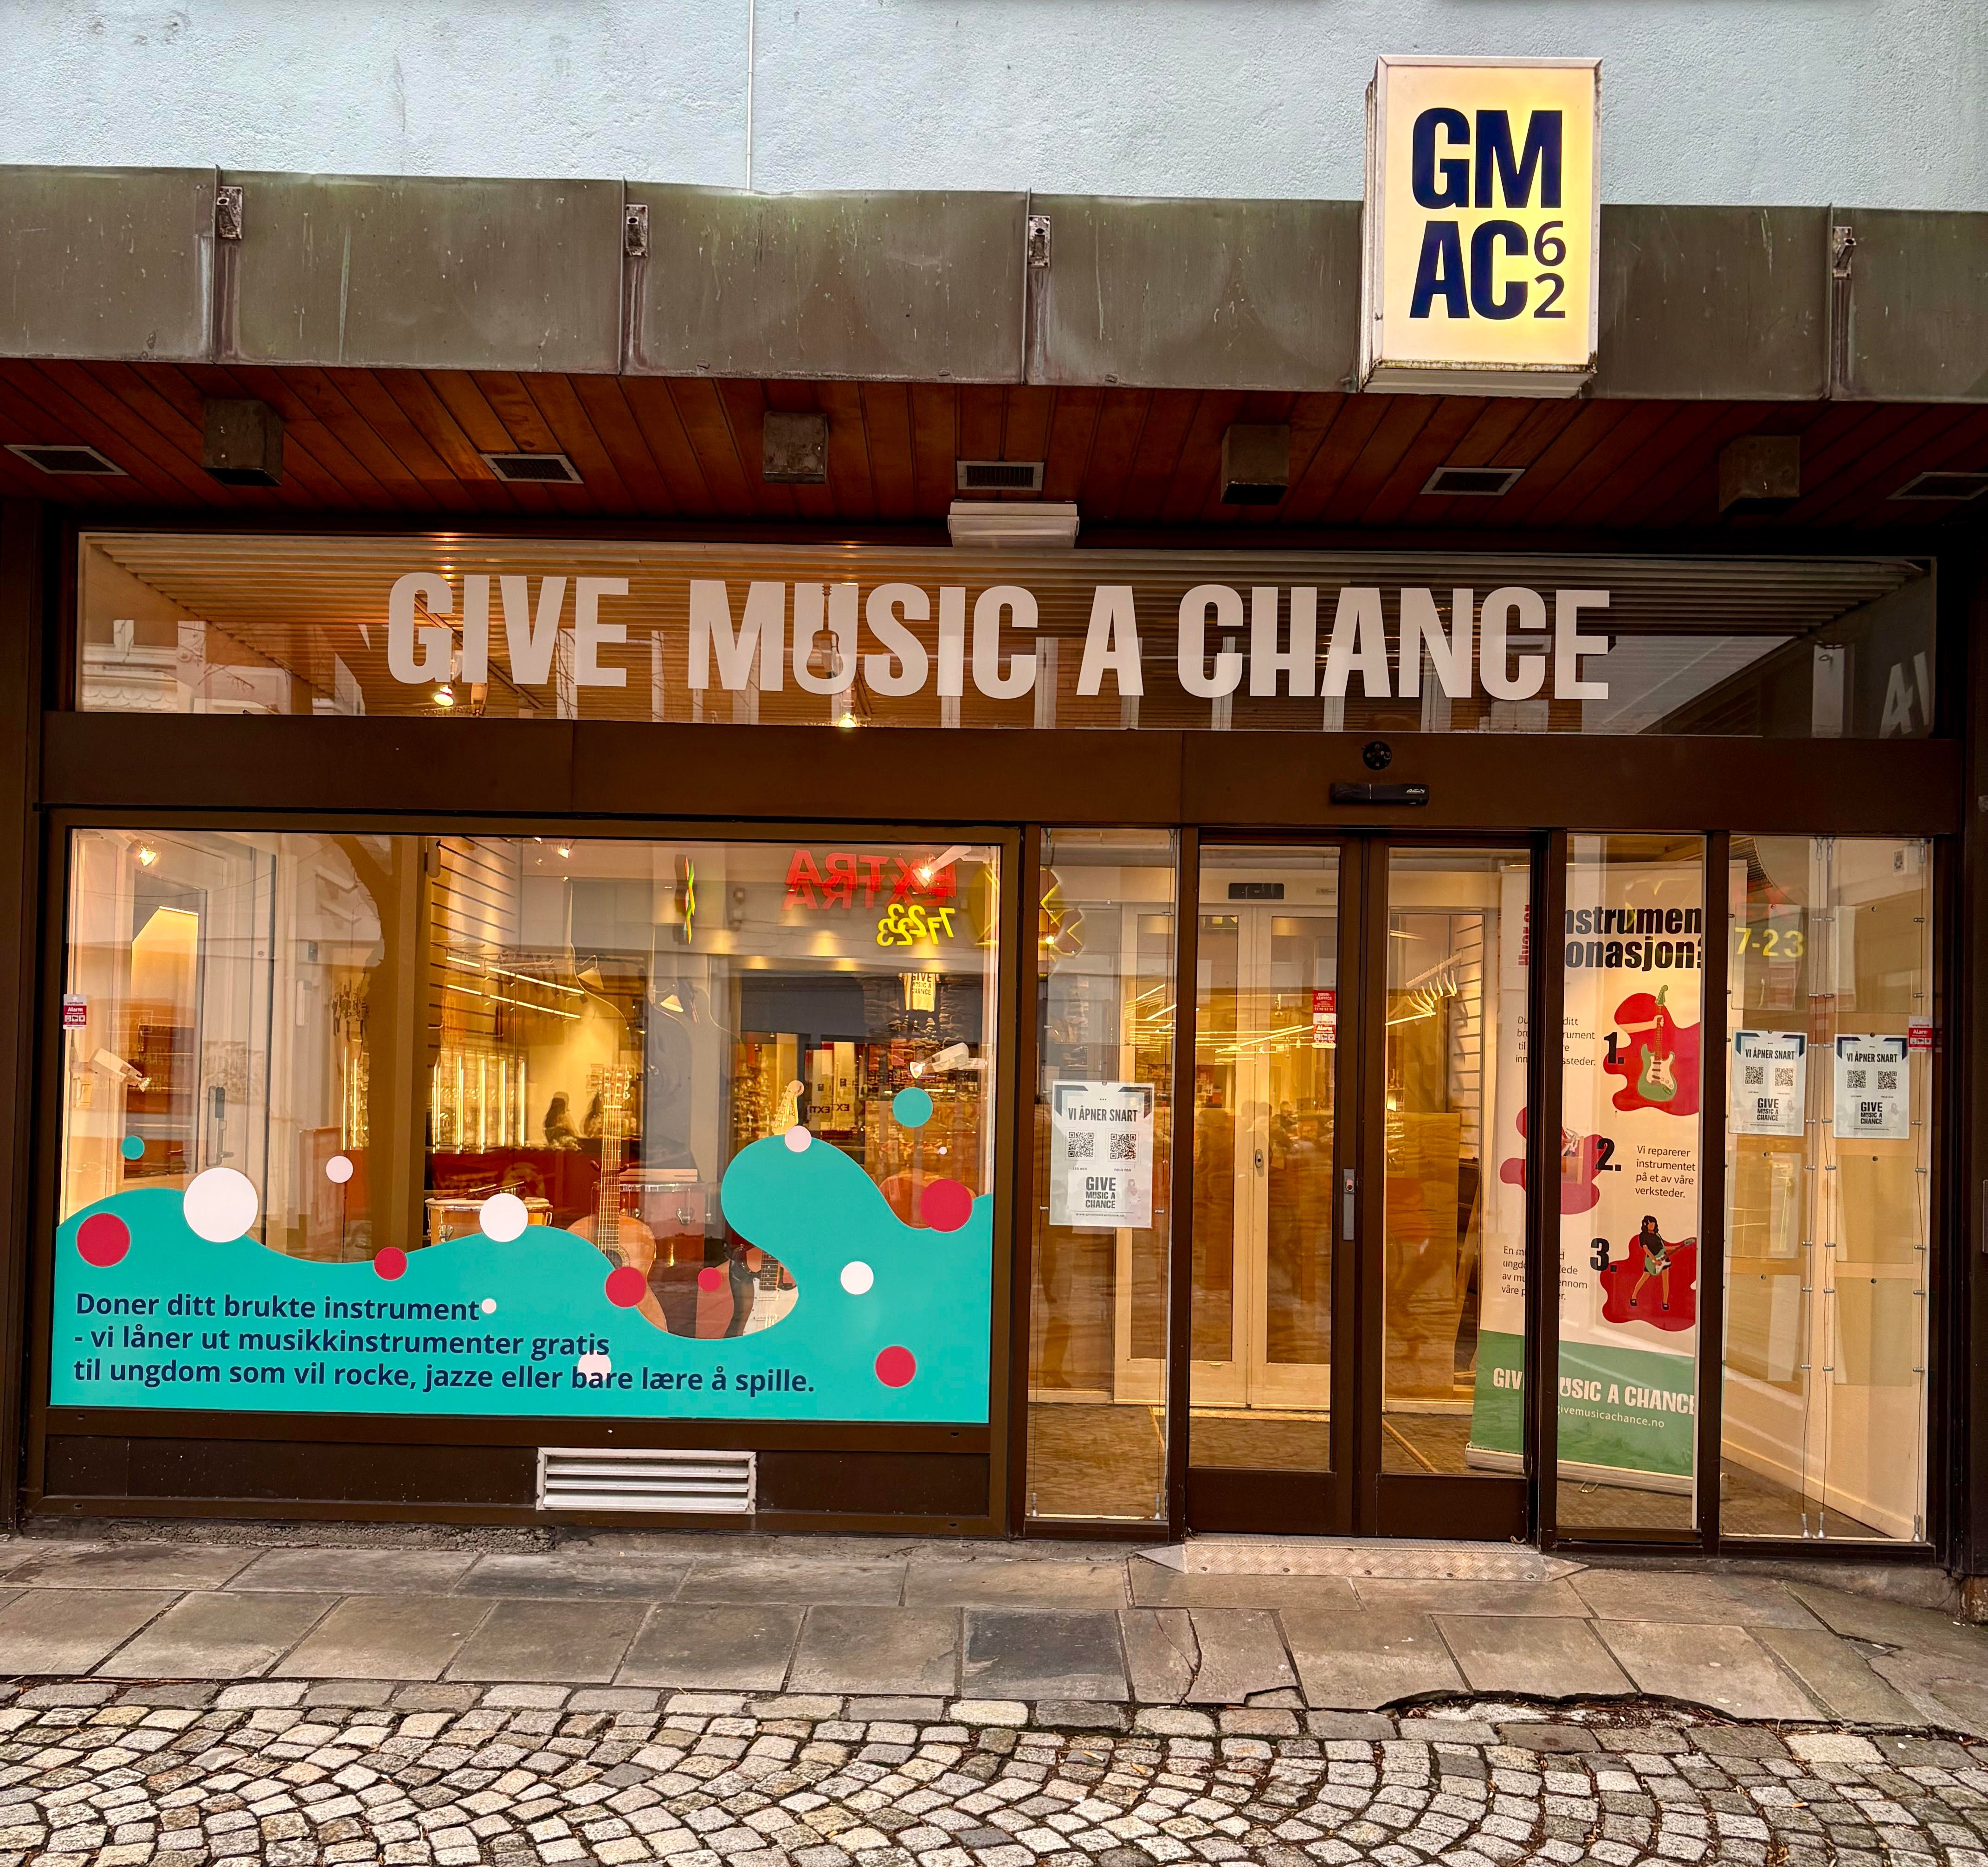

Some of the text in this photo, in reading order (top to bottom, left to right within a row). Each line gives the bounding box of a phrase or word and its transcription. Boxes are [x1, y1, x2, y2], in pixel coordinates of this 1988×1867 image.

[1412, 107, 1562, 209] GM
[1409, 219, 1529, 320] AC
[387, 572, 1610, 701] GIVE MUSIC A CHANCE
[1566, 907, 1702, 934] nstrumen
[1735, 927, 1804, 958] 7-23
[1565, 936, 1702, 972] onasjon
[1604, 1032, 1624, 1064] 1.
[1745, 1047, 1794, 1060] VI ÅPNER SNART
[1847, 1051, 1898, 1063] VI ÅPNER SNART
[1757, 1098, 1779, 1108] GIVE
[1860, 1101, 1883, 1112] GIVE
[1068, 1105, 1138, 1122] VI ÅPNER SNART
[1595, 1138, 1621, 1172] 2.
[1637, 1145, 1691, 1157] Vi reparerer
[1637, 1159, 1696, 1172] instrumentet
[1086, 1176, 1116, 1191] GIVE
[1636, 1172, 1647, 1183] på
[1650, 1174, 1659, 1182] et
[1674, 1174, 1694, 1185] våre
[1085, 1191, 1109, 1199] MUSIC
[1635, 1186, 1685, 1198] verksteder.
[1085, 1200, 1116, 1209] CHANCE
[1504, 1246, 1513, 1255] En
[1590, 1238, 1617, 1273] 3.
[1501, 1284, 1519, 1294] våre
[77, 1293, 479, 1320] Doner ditt brukte instrument
[90, 1325, 114, 1347] vi
[123, 1324, 194, 1348] låner
[202, 1330, 230, 1350] ut
[239, 1328, 524, 1354] musikkinstrumenter
[531, 1333, 609, 1361] gratis
[73, 1358, 814, 1397] til ungdom som vil rocke, jazze eller bare lære å spille.
[1493, 1368, 1524, 1390] GIV
[1559, 1377, 1601, 1401] USIC
[1607, 1384, 1619, 1404] A
